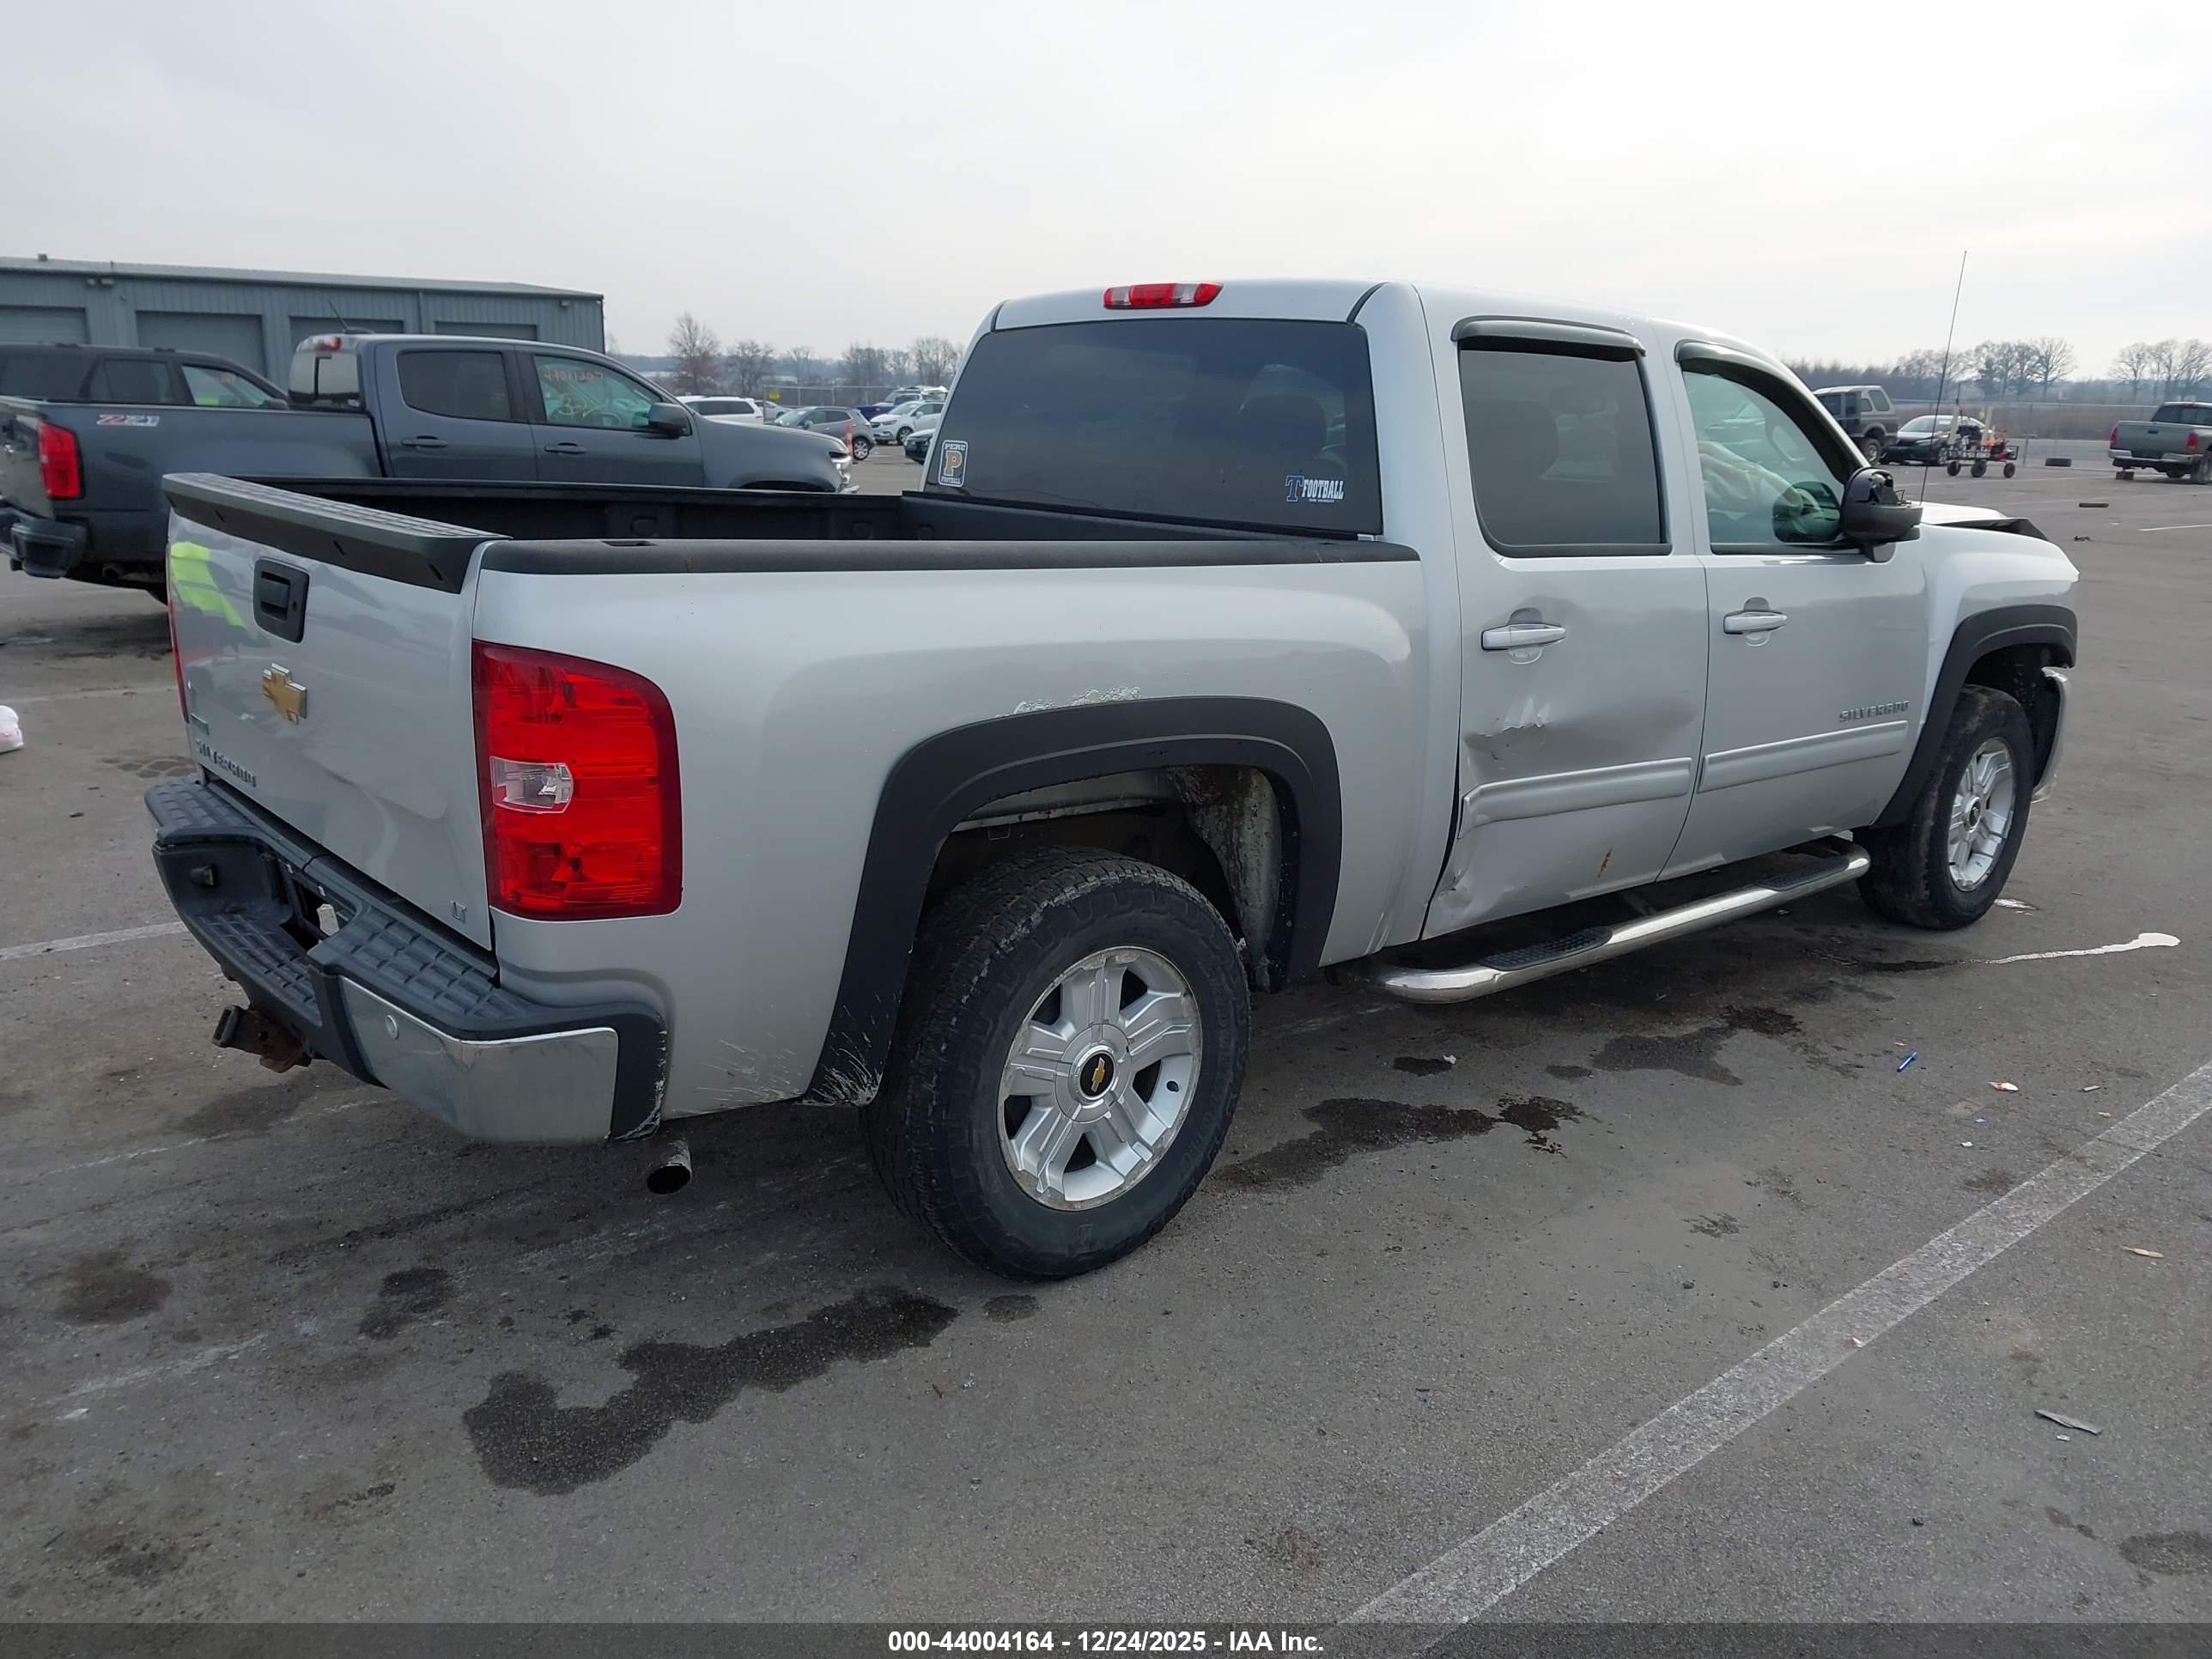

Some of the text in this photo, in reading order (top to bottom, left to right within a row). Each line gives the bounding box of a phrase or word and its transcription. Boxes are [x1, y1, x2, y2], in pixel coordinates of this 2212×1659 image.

[944, 450, 963, 477] P
[1285, 475, 1344, 502] T FOOTBALL
[1839, 700, 1910, 722] SILVERADO
[451, 900, 467, 924] LT
